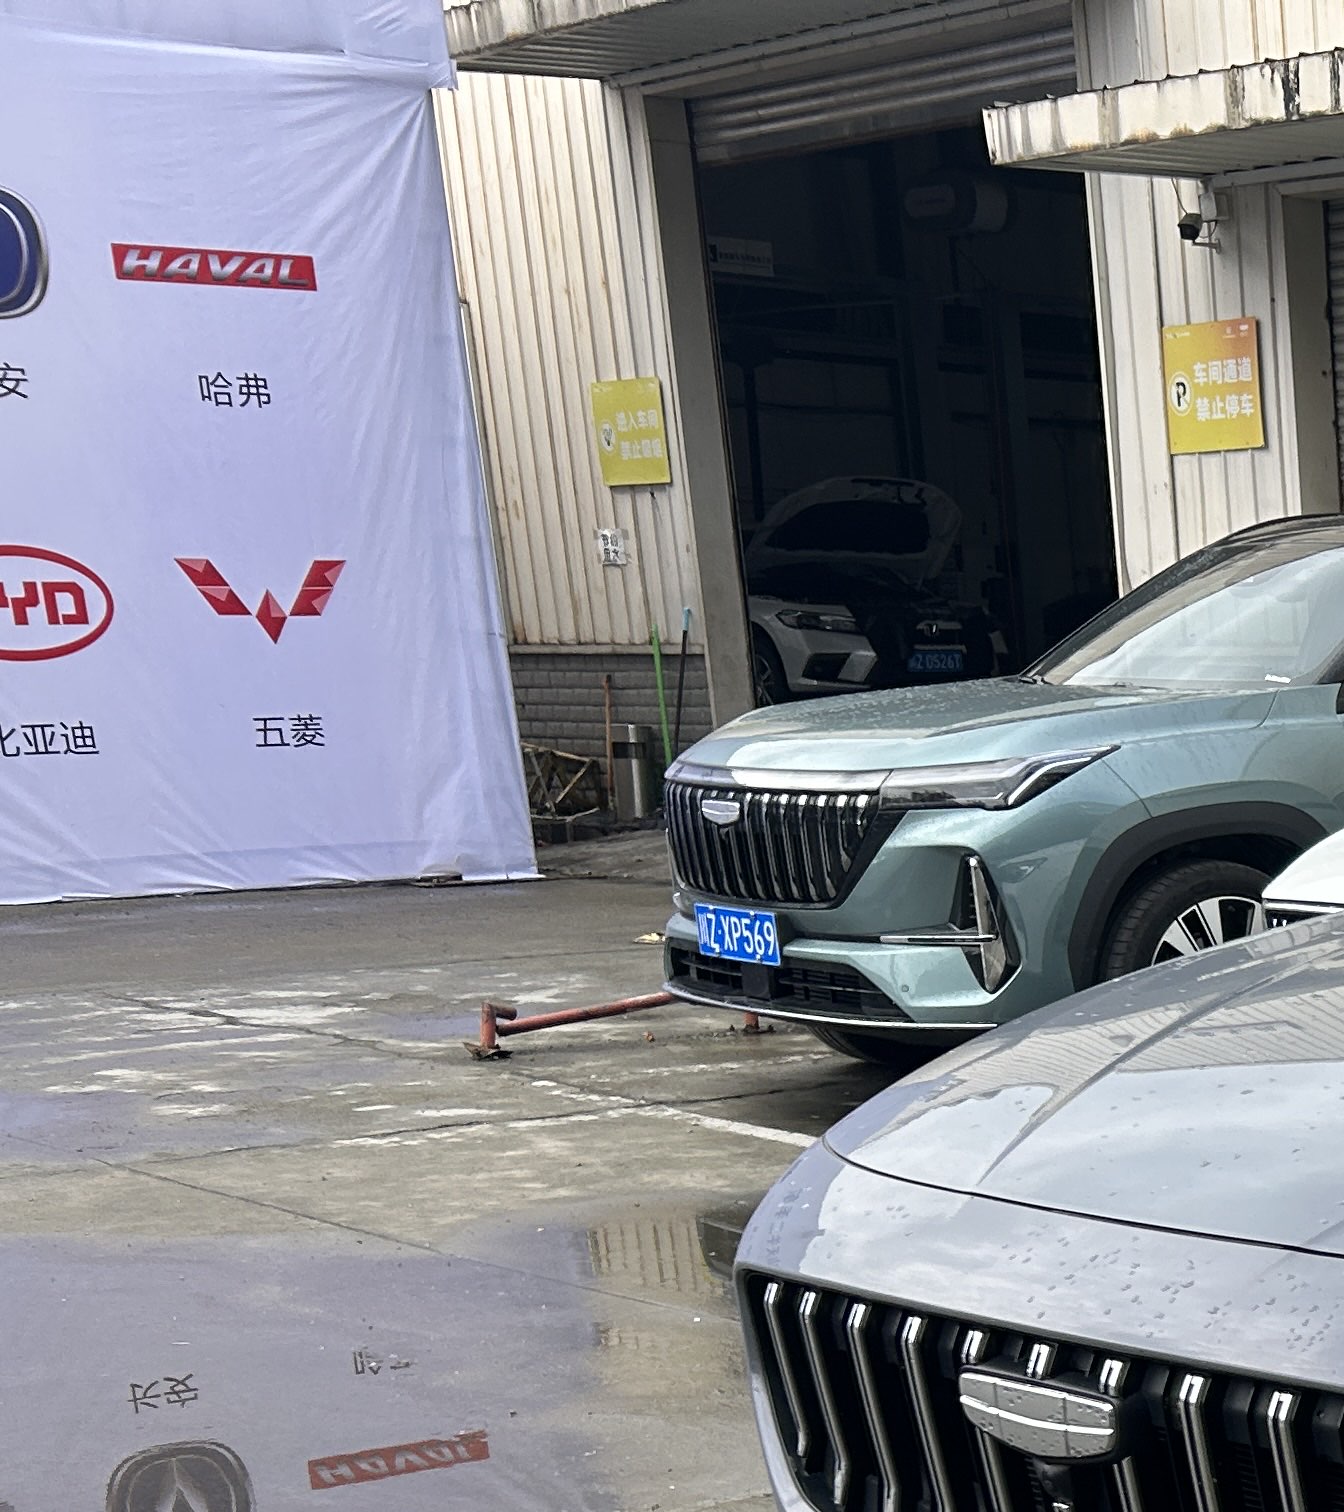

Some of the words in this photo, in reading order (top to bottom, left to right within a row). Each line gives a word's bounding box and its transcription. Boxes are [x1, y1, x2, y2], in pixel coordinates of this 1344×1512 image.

[122, 249, 309, 287] HAVAL
[1193, 357, 1252, 386] 车间通道
[198, 372, 272, 408] 哈弗
[1196, 394, 1255, 421] 禁止停车
[0, 581, 90, 626] YD
[252, 714, 326, 748] 五菱
